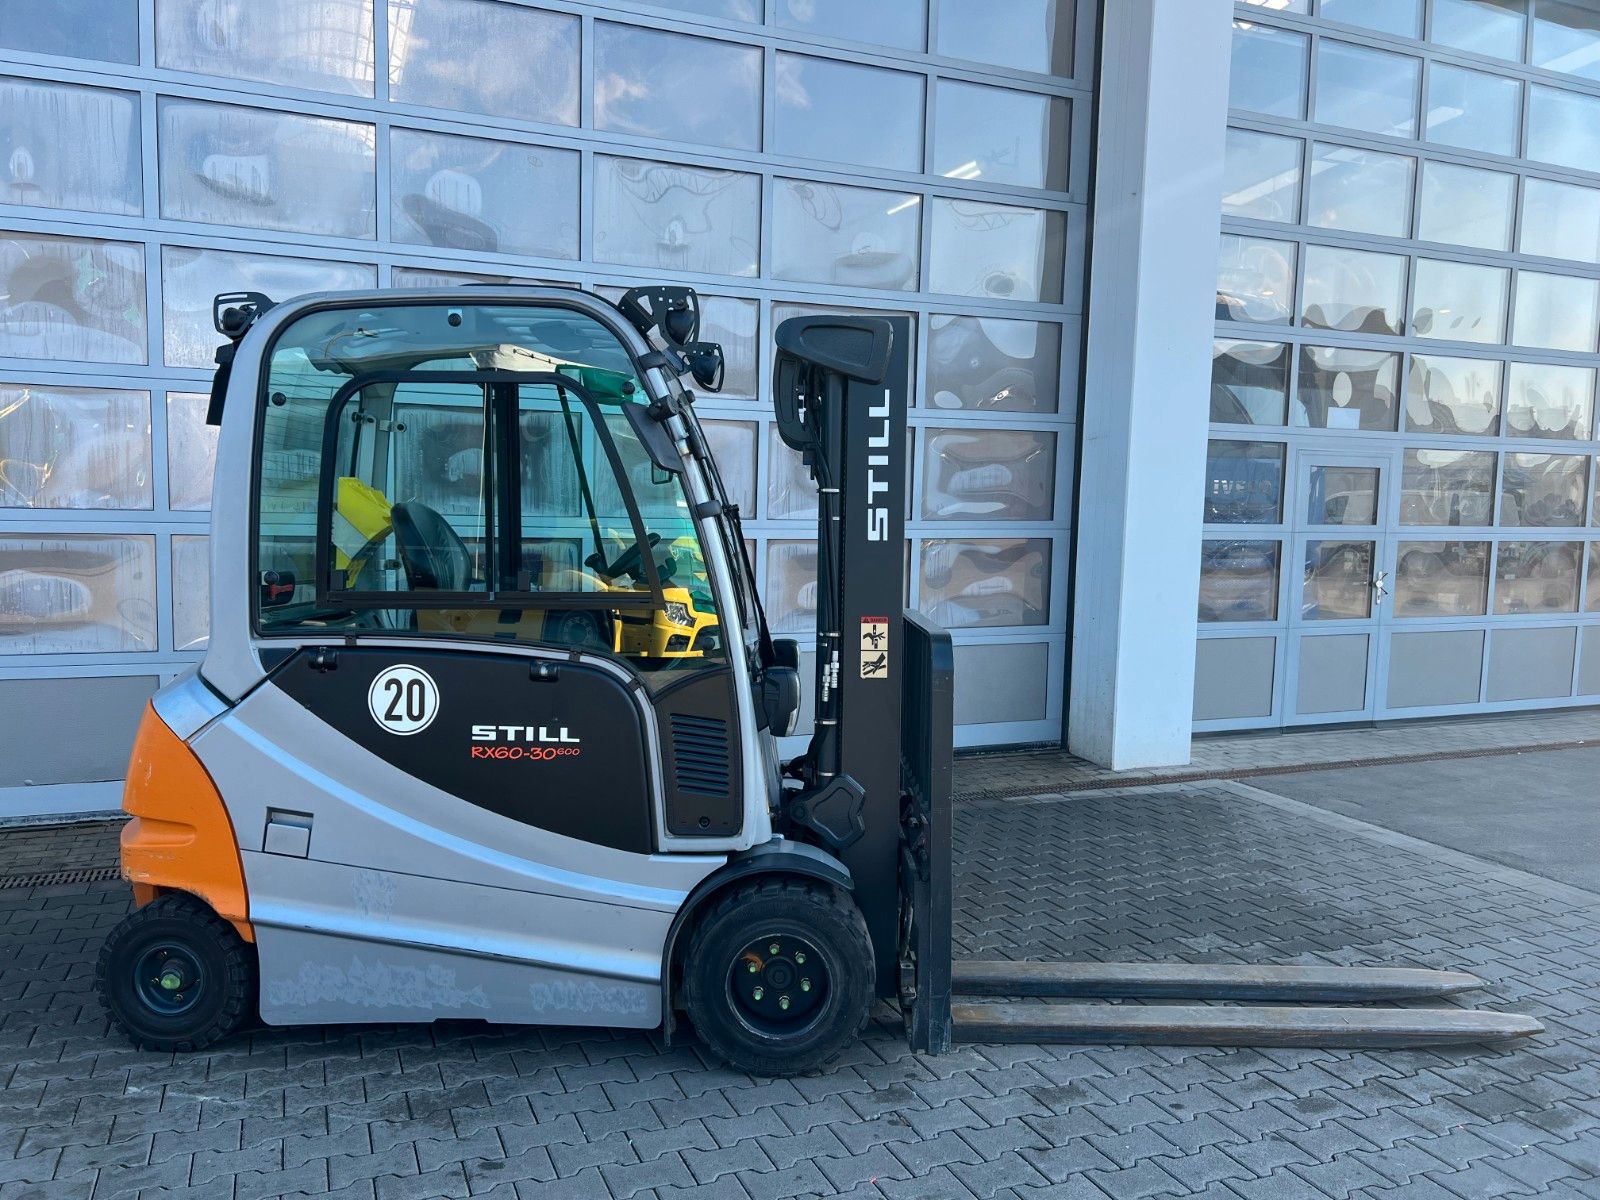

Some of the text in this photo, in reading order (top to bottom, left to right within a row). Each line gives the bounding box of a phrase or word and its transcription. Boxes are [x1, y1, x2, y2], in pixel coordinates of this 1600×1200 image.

[867, 389, 890, 541] STILL
[1213, 479, 1272, 495] IVEO
[384, 678, 425, 722] 20
[472, 725, 580, 743] STILL
